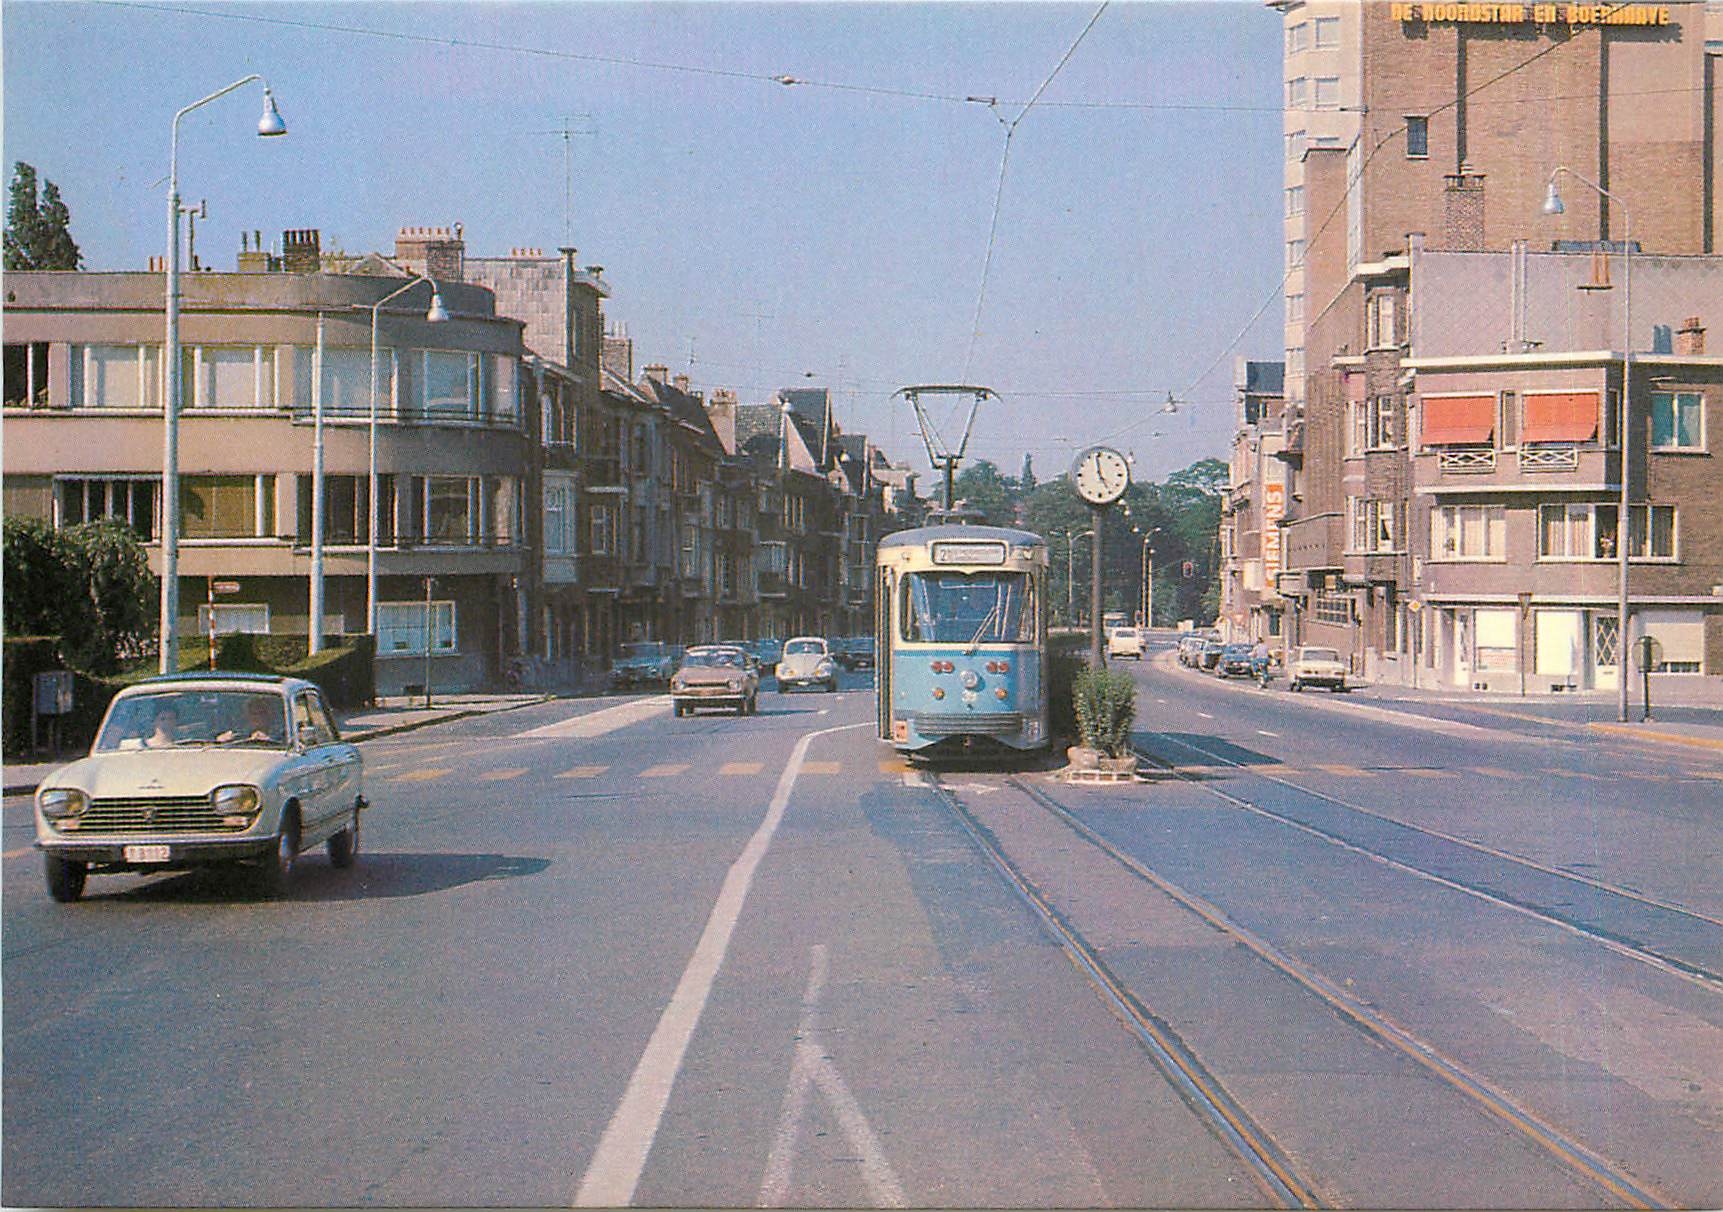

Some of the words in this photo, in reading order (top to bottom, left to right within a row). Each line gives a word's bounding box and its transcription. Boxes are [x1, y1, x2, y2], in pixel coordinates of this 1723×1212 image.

[1391, 3, 1413, 21] DE
[1421, 3, 1524, 23] NOORDSTAR
[1533, 5, 1556, 23] EN
[1264, 492, 1284, 581] SIEMENS
